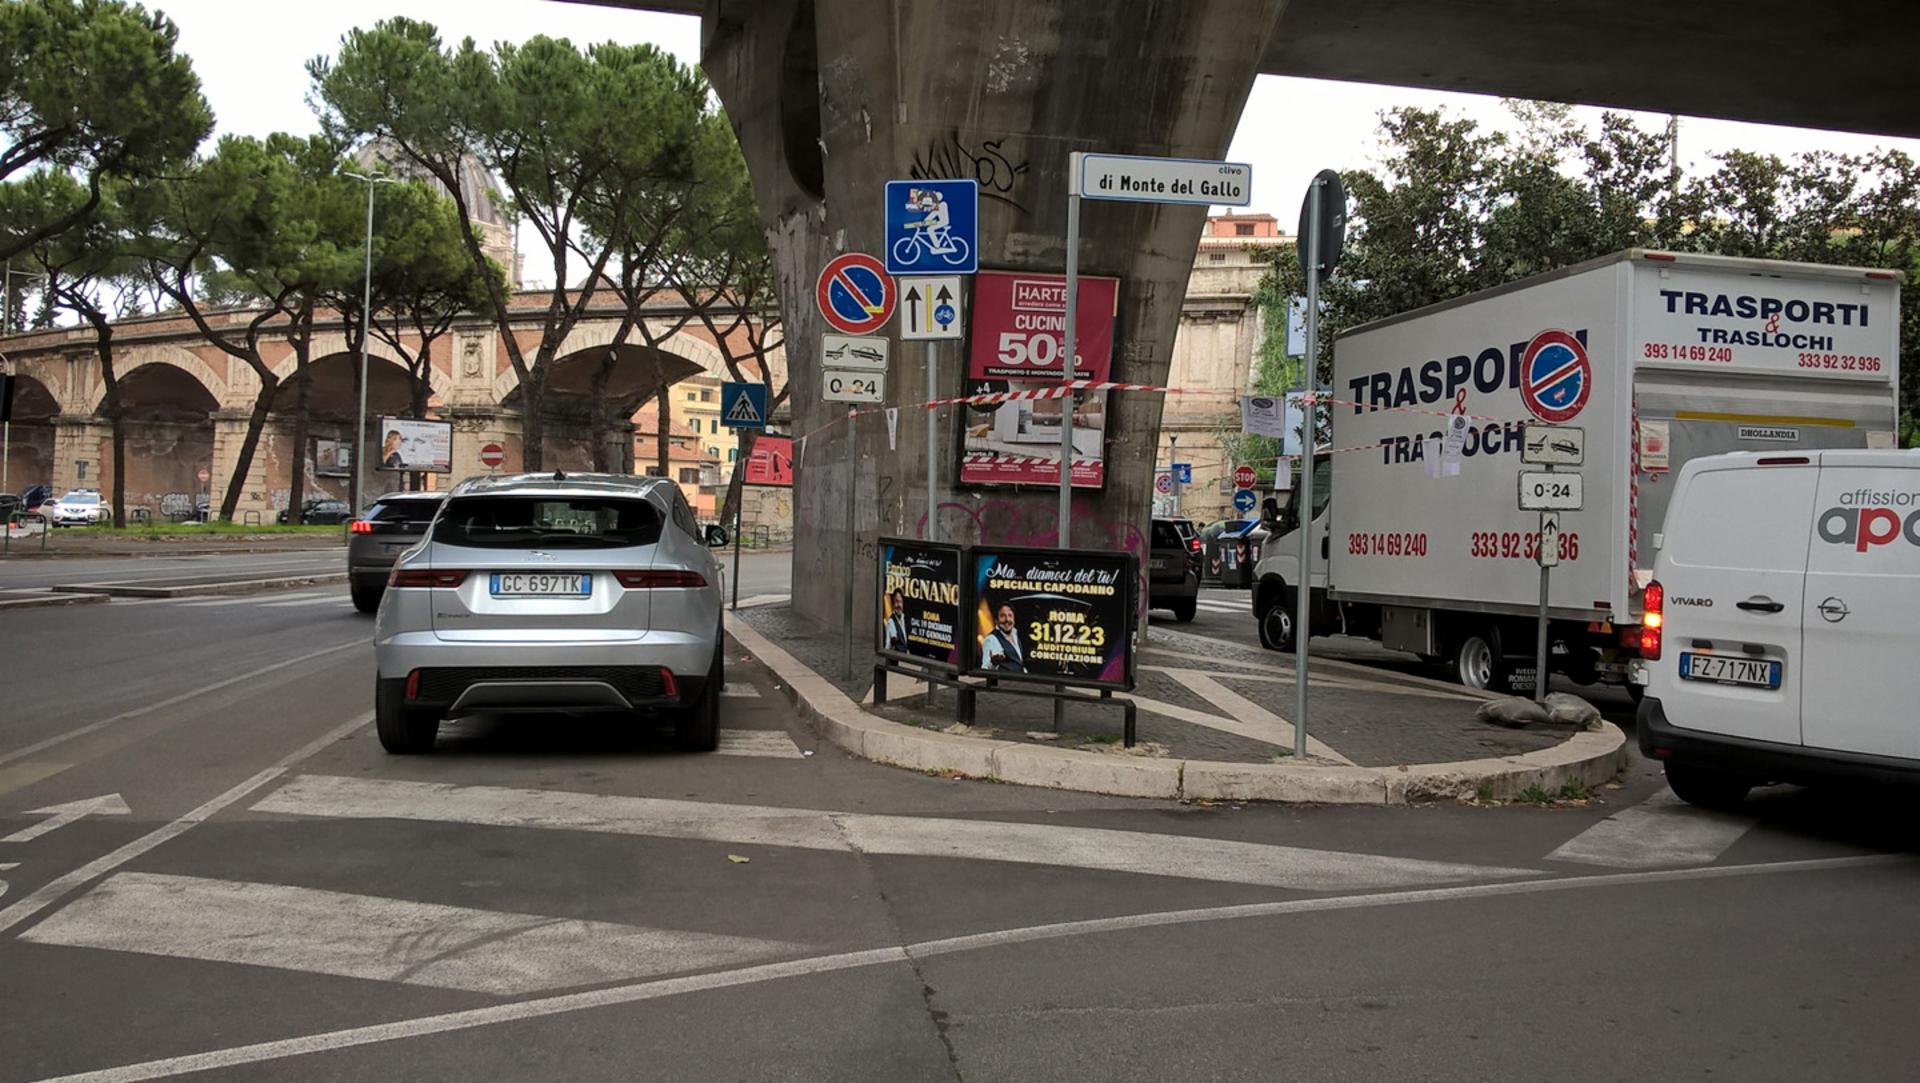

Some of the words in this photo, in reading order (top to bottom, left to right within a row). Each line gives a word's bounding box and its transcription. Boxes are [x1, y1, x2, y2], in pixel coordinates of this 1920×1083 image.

[1218, 166, 1242, 175] clivo
[1099, 174, 1113, 190] di
[1121, 176, 1165, 193] Monte
[1171, 179, 1194, 194] del
[1200, 181, 1241, 197] Gallo
[1660, 289, 1869, 327] TRASPORTI
[1015, 314, 1067, 331] CUCIN
[1765, 313, 1780, 334] &
[1697, 327, 1833, 351] TRASLOCHI
[1644, 343, 1668, 359] 393
[1672, 345, 1687, 360] 14
[1690, 346, 1705, 361] 69
[1708, 347, 1732, 362] 240
[1798, 352, 1821, 368] 333
[1823, 354, 1838, 369] 92
[1841, 355, 1856, 370] 32
[1858, 356, 1881, 371] 936
[1031, 369, 1065, 377] MONTAGGI
[1349, 329, 1588, 415] TRASPOR
[1452, 387, 1467, 415] &
[1380, 418, 1536, 465] TRASOCH
[1740, 429, 1797, 440] DHOLLANDIA
[1235, 472, 1255, 482] STOP
[1534, 483, 1571, 498] 0-24
[1349, 533, 1369, 555] 393
[1371, 534, 1385, 555] 14
[1387, 533, 1402, 556] 69
[1404, 533, 1427, 556] 240
[1471, 532, 1498, 558] 333
[1501, 532, 1520, 559] 92
[1558, 532, 1579, 561] 36
[886, 561, 911, 577] Enrico
[1026, 566, 1072, 582] diamoci
[1074, 569, 1095, 584] del
[502, 575, 522, 592] GC
[529, 575, 580, 592] 697TK
[989, 579, 1042, 592] SPECIALE
[1043, 582, 1115, 596] CAPODANNO
[1671, 596, 1714, 607] VIVARO
[1049, 610, 1085, 623] ROMA
[1029, 621, 1105, 646] 31.12.23
[1030, 651, 1103, 664] CONCILIAZIONE
[1037, 643, 1096, 655] AUDITORIUM
[1508, 674, 1537, 682] ROMAN
[1691, 657, 1711, 676] FZ
[1717, 660, 1768, 682] 717NX
